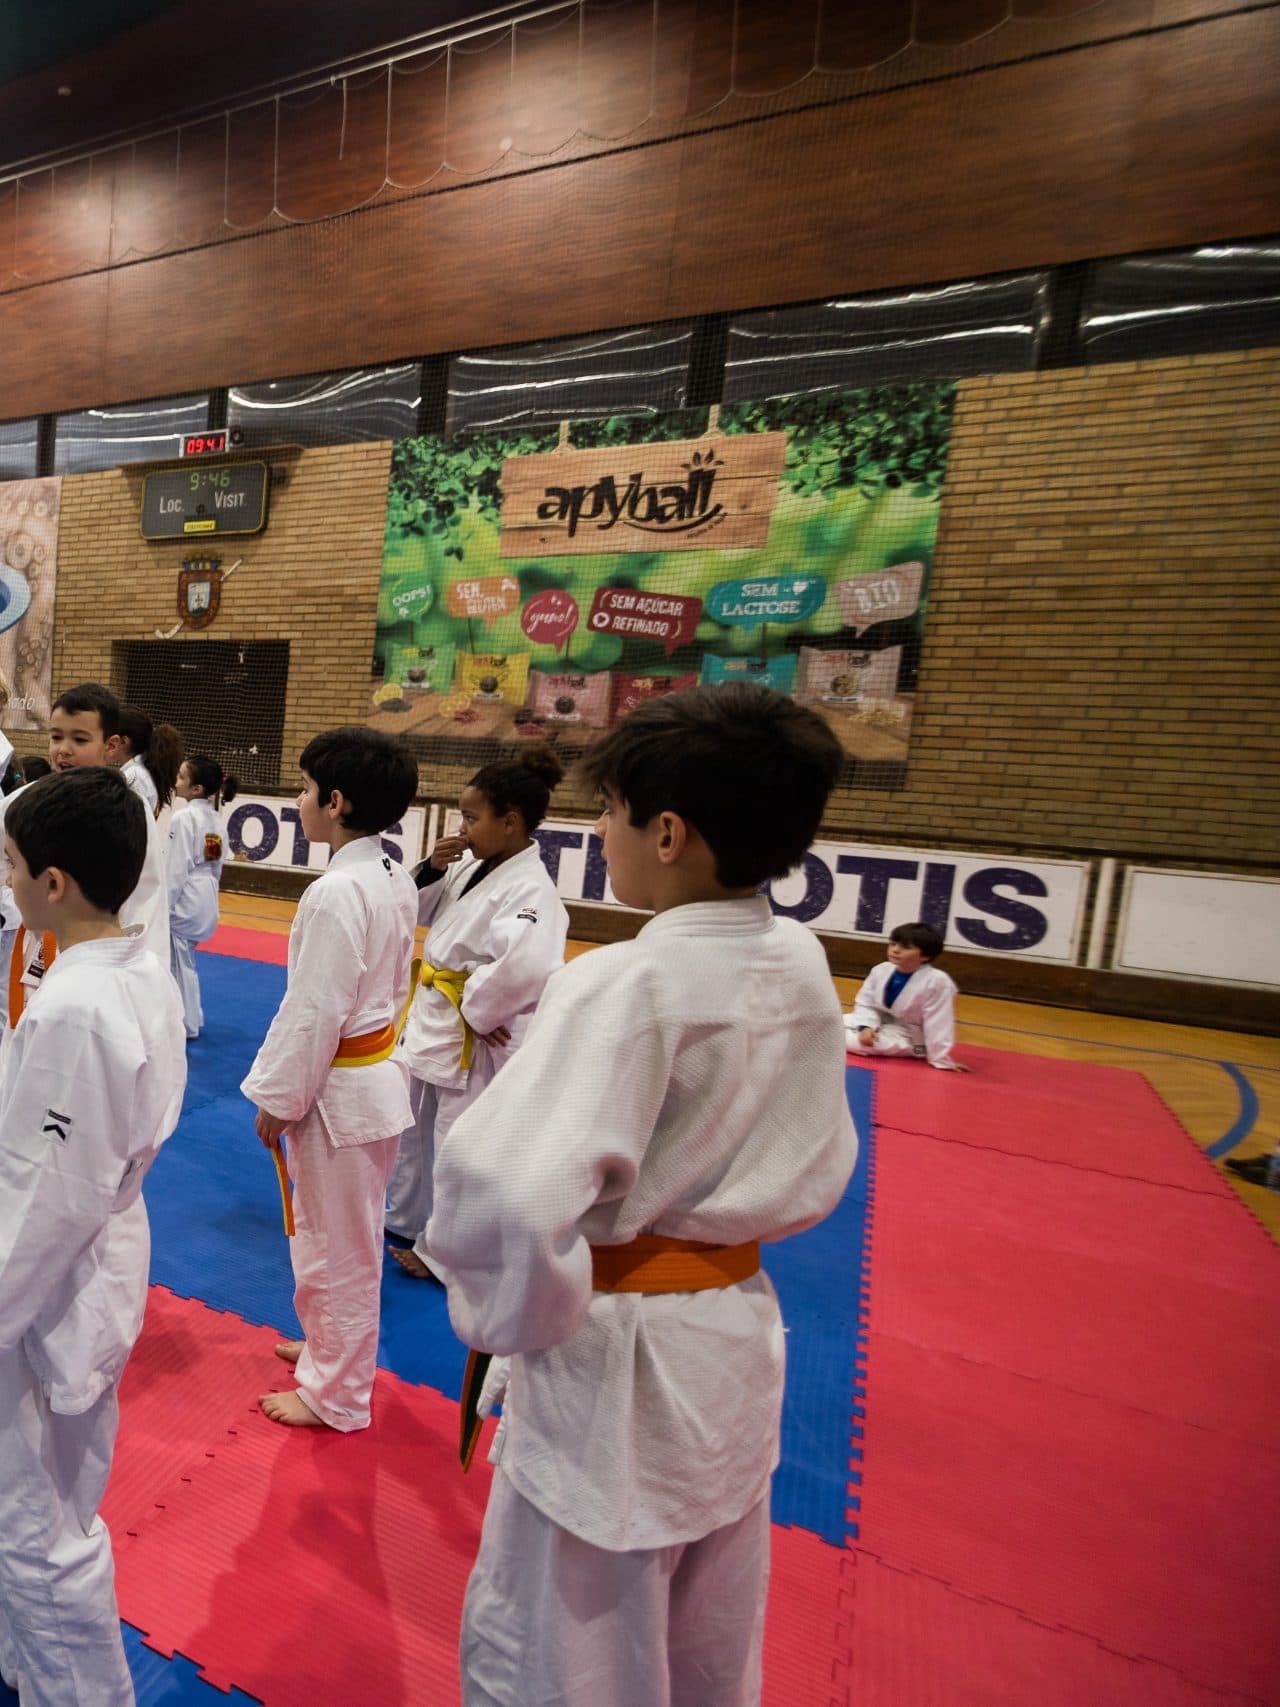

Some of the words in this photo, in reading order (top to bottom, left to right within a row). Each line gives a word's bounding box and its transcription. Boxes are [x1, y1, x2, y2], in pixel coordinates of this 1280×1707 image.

[190, 471, 231, 491] 9:46
[537, 468, 716, 538] apyball
[741, 583, 779, 597] SEM
[609, 594, 635, 610] SEM
[721, 600, 800, 617] LACTOSE
[612, 616, 669, 636] REFINADO
[757, 851, 1049, 950] OTIS
